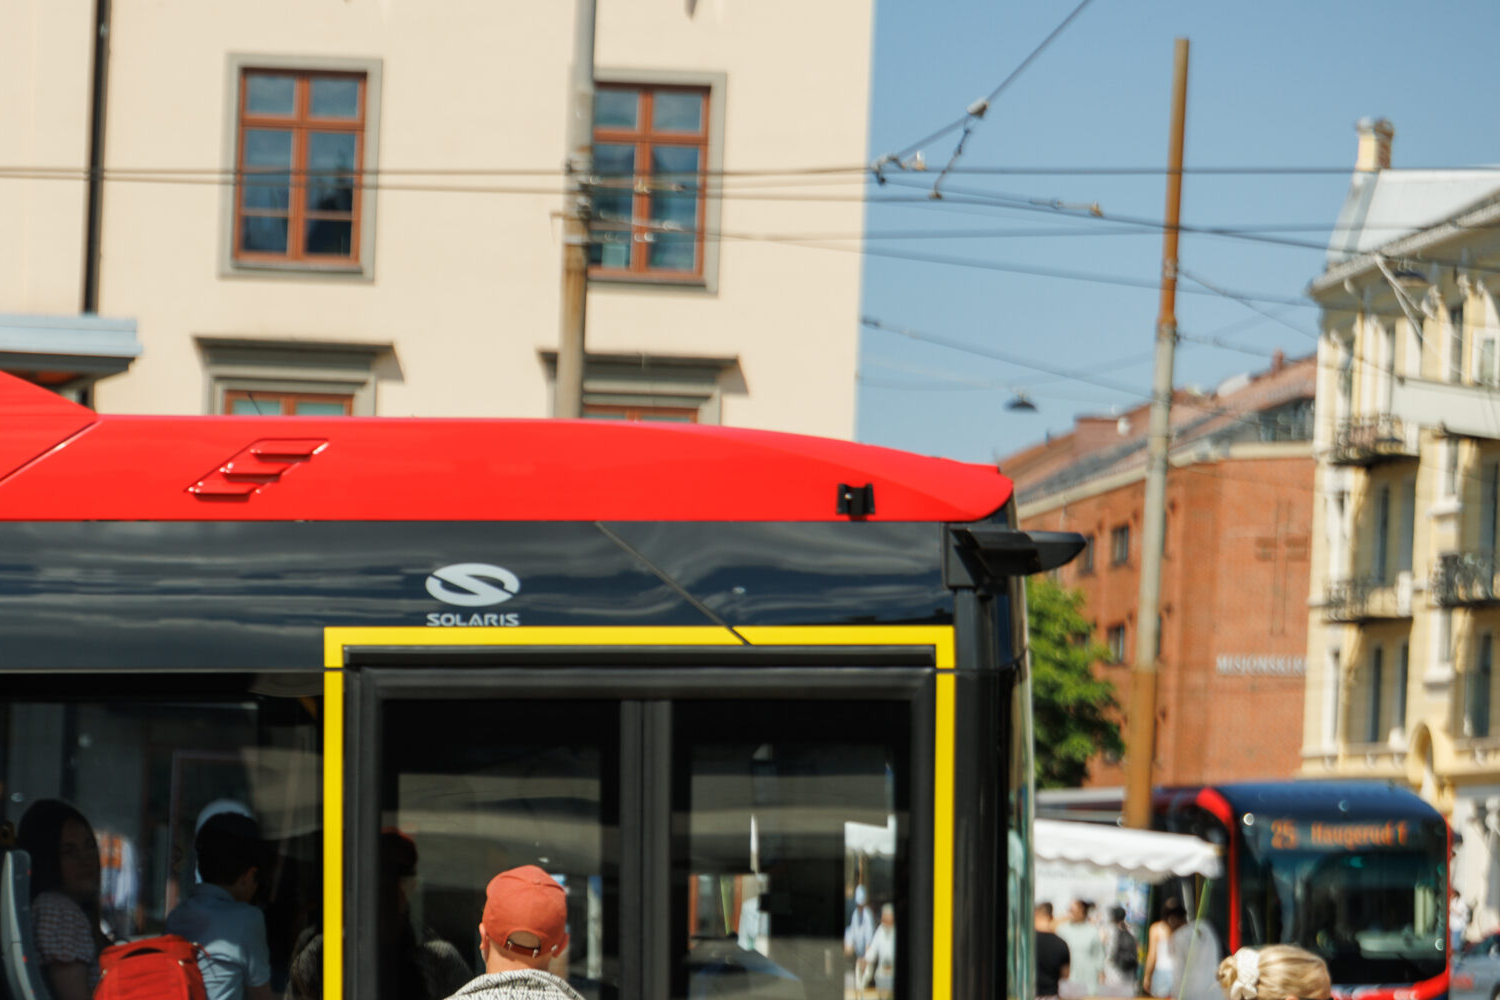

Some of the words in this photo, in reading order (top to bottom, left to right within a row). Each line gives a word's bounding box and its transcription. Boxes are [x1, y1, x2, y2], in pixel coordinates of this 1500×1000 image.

[426, 613, 520, 626] SOLARIS
[1216, 654, 1307, 674] MISJONSKIR
[1271, 818, 1298, 849] 25
[1311, 820, 1394, 850] Haugerud
